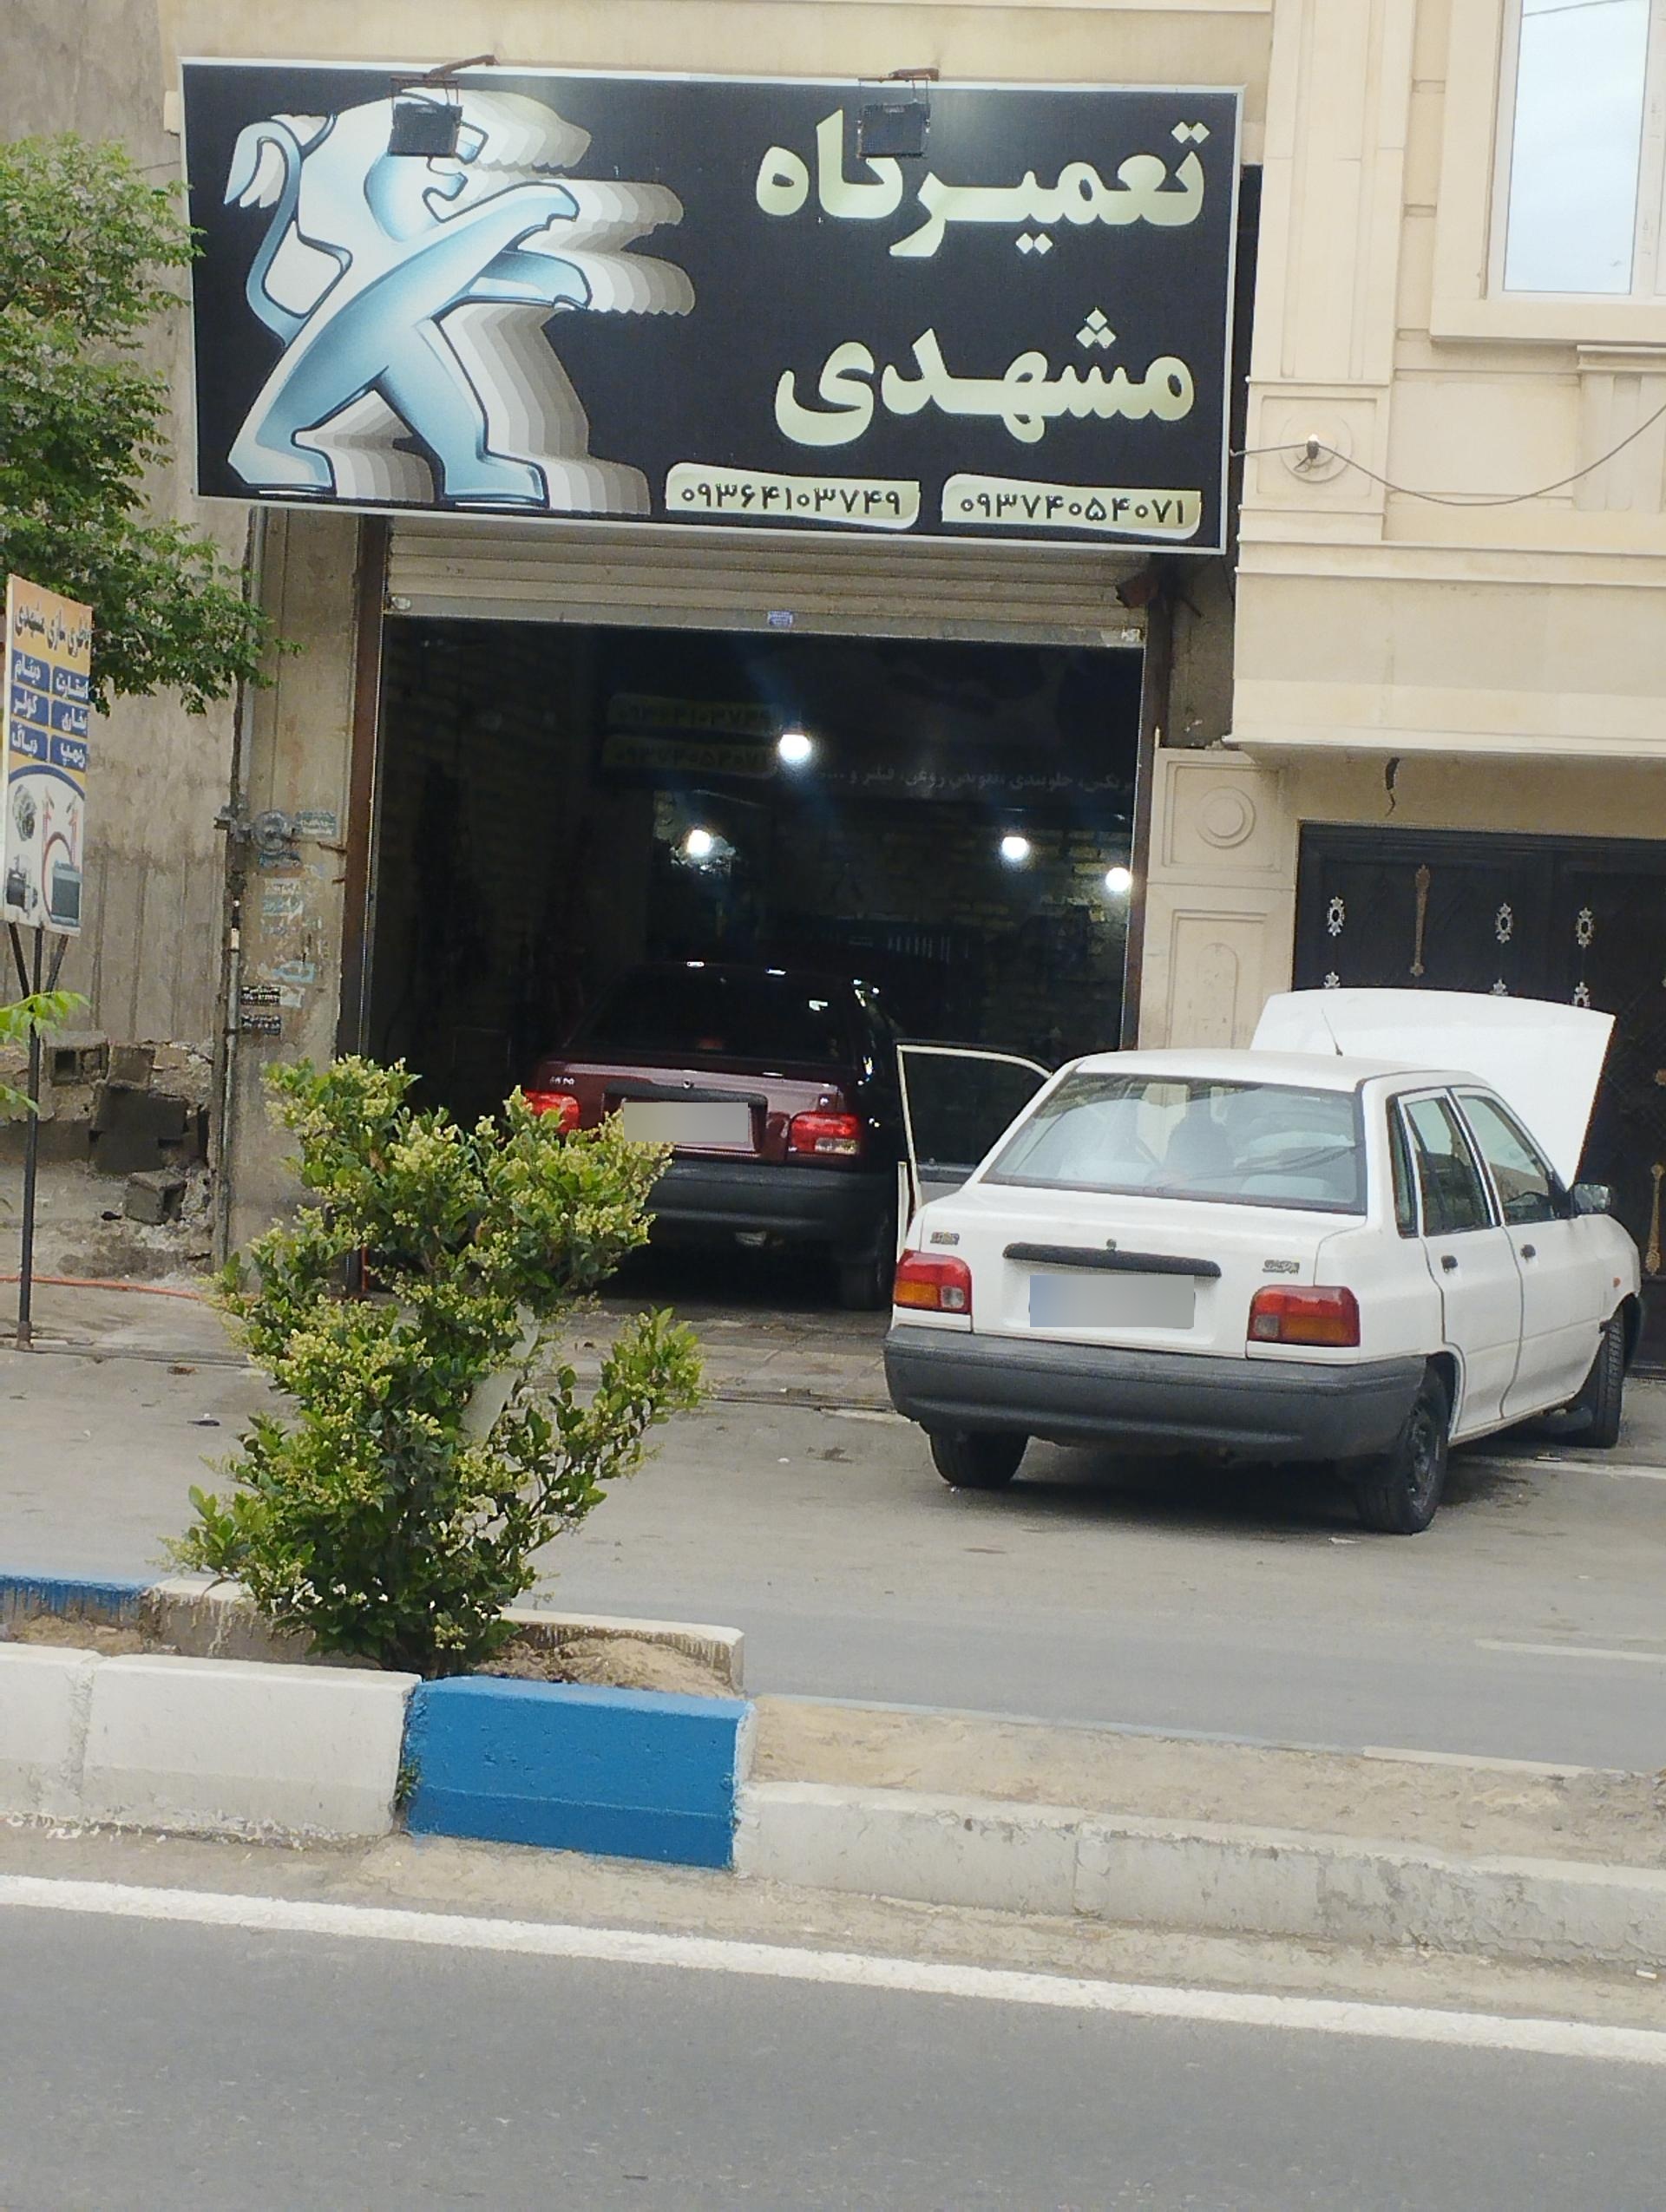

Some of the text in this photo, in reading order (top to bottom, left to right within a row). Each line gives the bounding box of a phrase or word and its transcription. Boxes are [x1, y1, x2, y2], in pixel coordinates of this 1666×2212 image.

[774, 306, 1196, 447] مشهدی
[680, 482, 902, 518] ۰۹۳۶۴۱۰۳۷۴۹
[960, 494, 1185, 525] ۰۹۳۷۴۰۵۴۰۷۱
[56, 672, 89, 700] استارت
